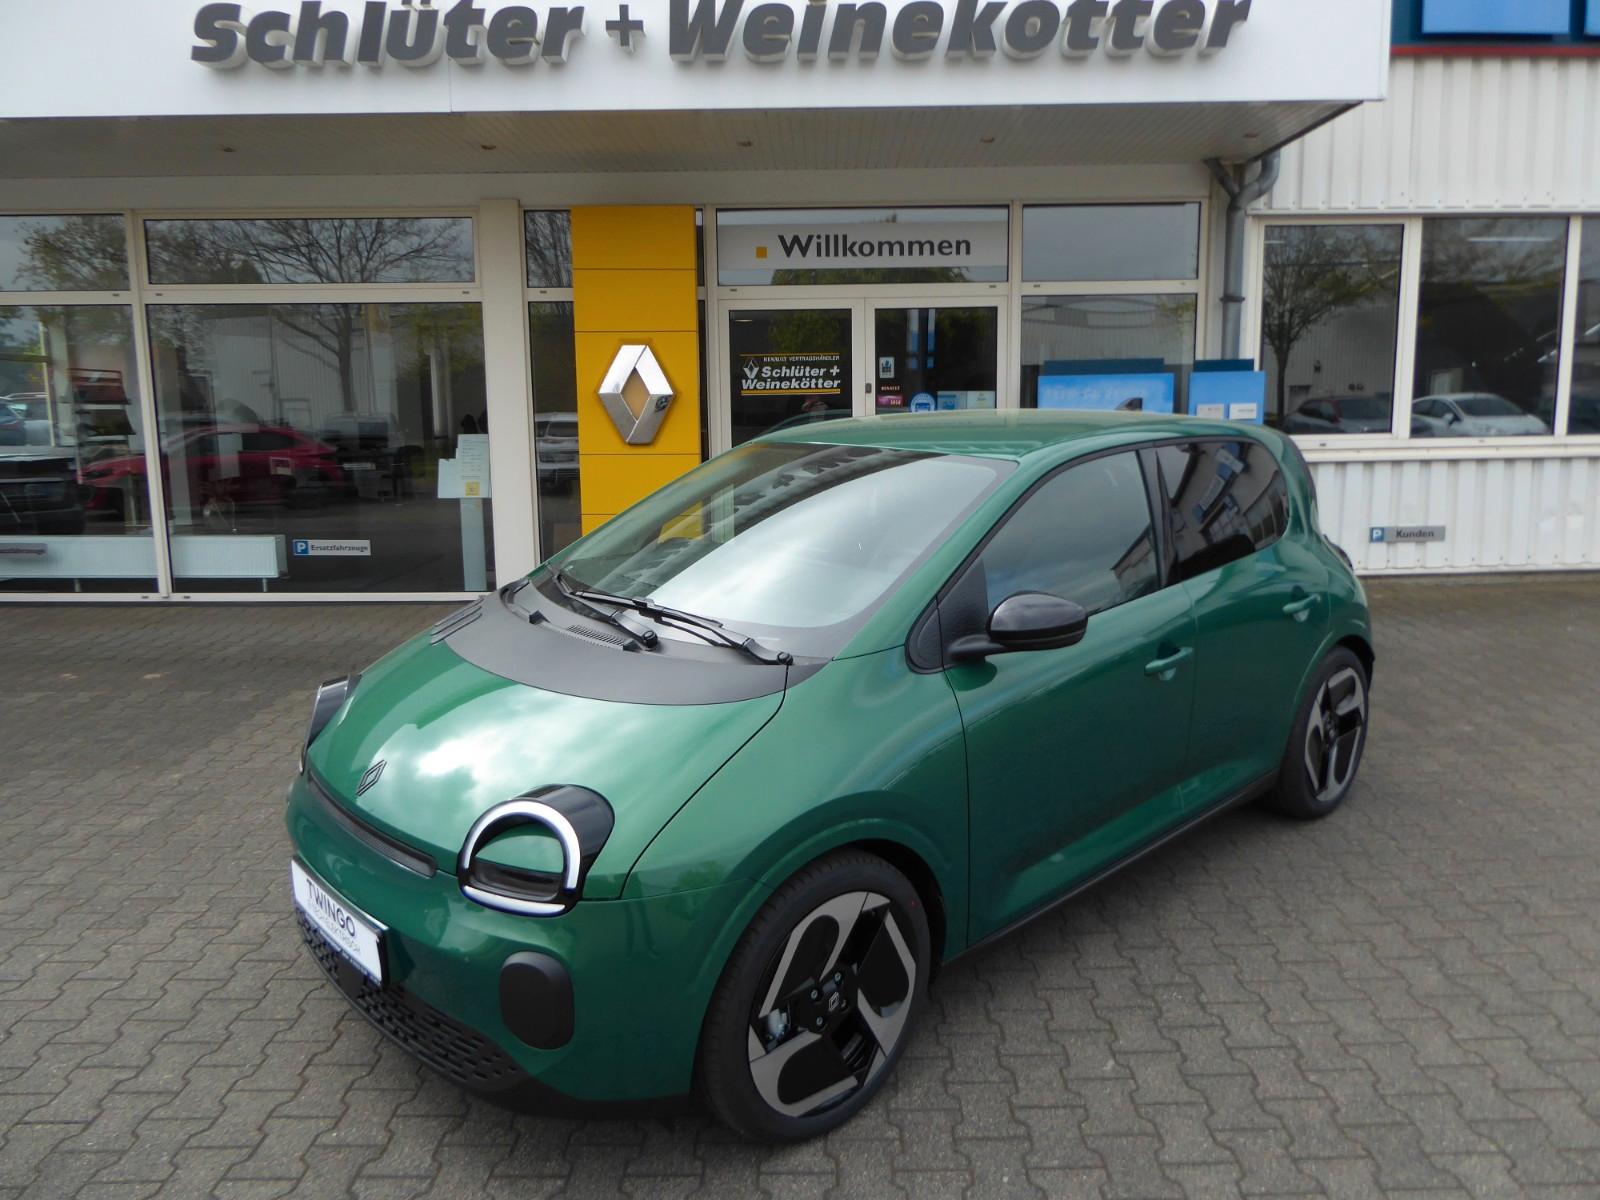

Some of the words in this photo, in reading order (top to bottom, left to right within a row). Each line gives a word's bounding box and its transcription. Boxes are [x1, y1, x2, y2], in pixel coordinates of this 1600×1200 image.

[191, 0, 586, 68] Schlüter
[605, 4, 646, 50] +
[778, 234, 972, 258] Willkommen
[761, 365, 826, 378] Schlüter
[829, 365, 840, 377] +
[741, 378, 840, 390] Weinekötter
[1396, 528, 1434, 538] Kunden
[311, 544, 369, 553] Ersatzfahrzeuge
[306, 878, 356, 937] TWINGO
